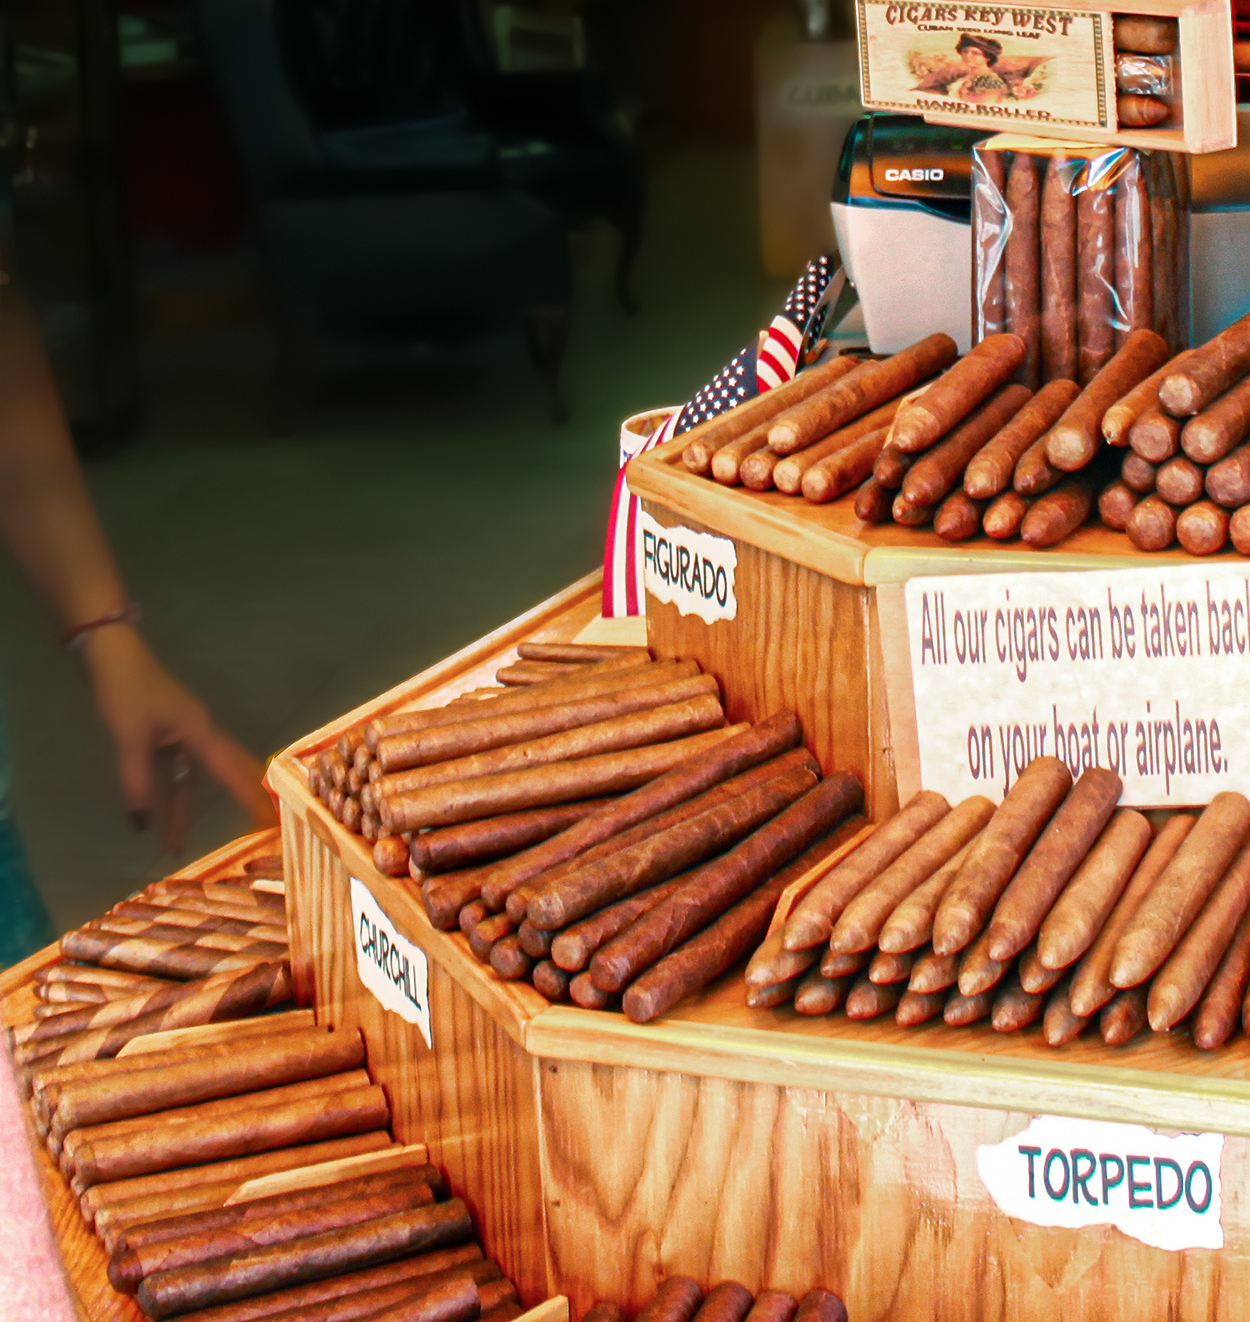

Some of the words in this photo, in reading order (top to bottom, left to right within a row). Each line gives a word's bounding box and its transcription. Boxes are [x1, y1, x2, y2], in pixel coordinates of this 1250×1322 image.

[885, 5, 958, 24] CIGARS
[964, 9, 1004, 26] KEY
[1011, 12, 1073, 36] WEST
[917, 24, 953, 32] CUBAN
[1016, 31, 1041, 40] LEAF
[916, 99, 969, 111] HAND
[976, 104, 1051, 118] ROLLED
[884, 168, 944, 182] CASIO
[642, 528, 729, 608] FIGURADO
[920, 590, 949, 665] All
[954, 609, 988, 664] our
[996, 589, 1059, 682] cigars
[1066, 605, 1104, 661] can
[1110, 585, 1136, 658] be
[1140, 582, 1201, 657] taken
[967, 724, 994, 779] on
[1136, 700, 1229, 794] airplane.
[360, 912, 422, 1012] CHURCHILL
[1019, 1145, 1212, 1214] TORPEDO
